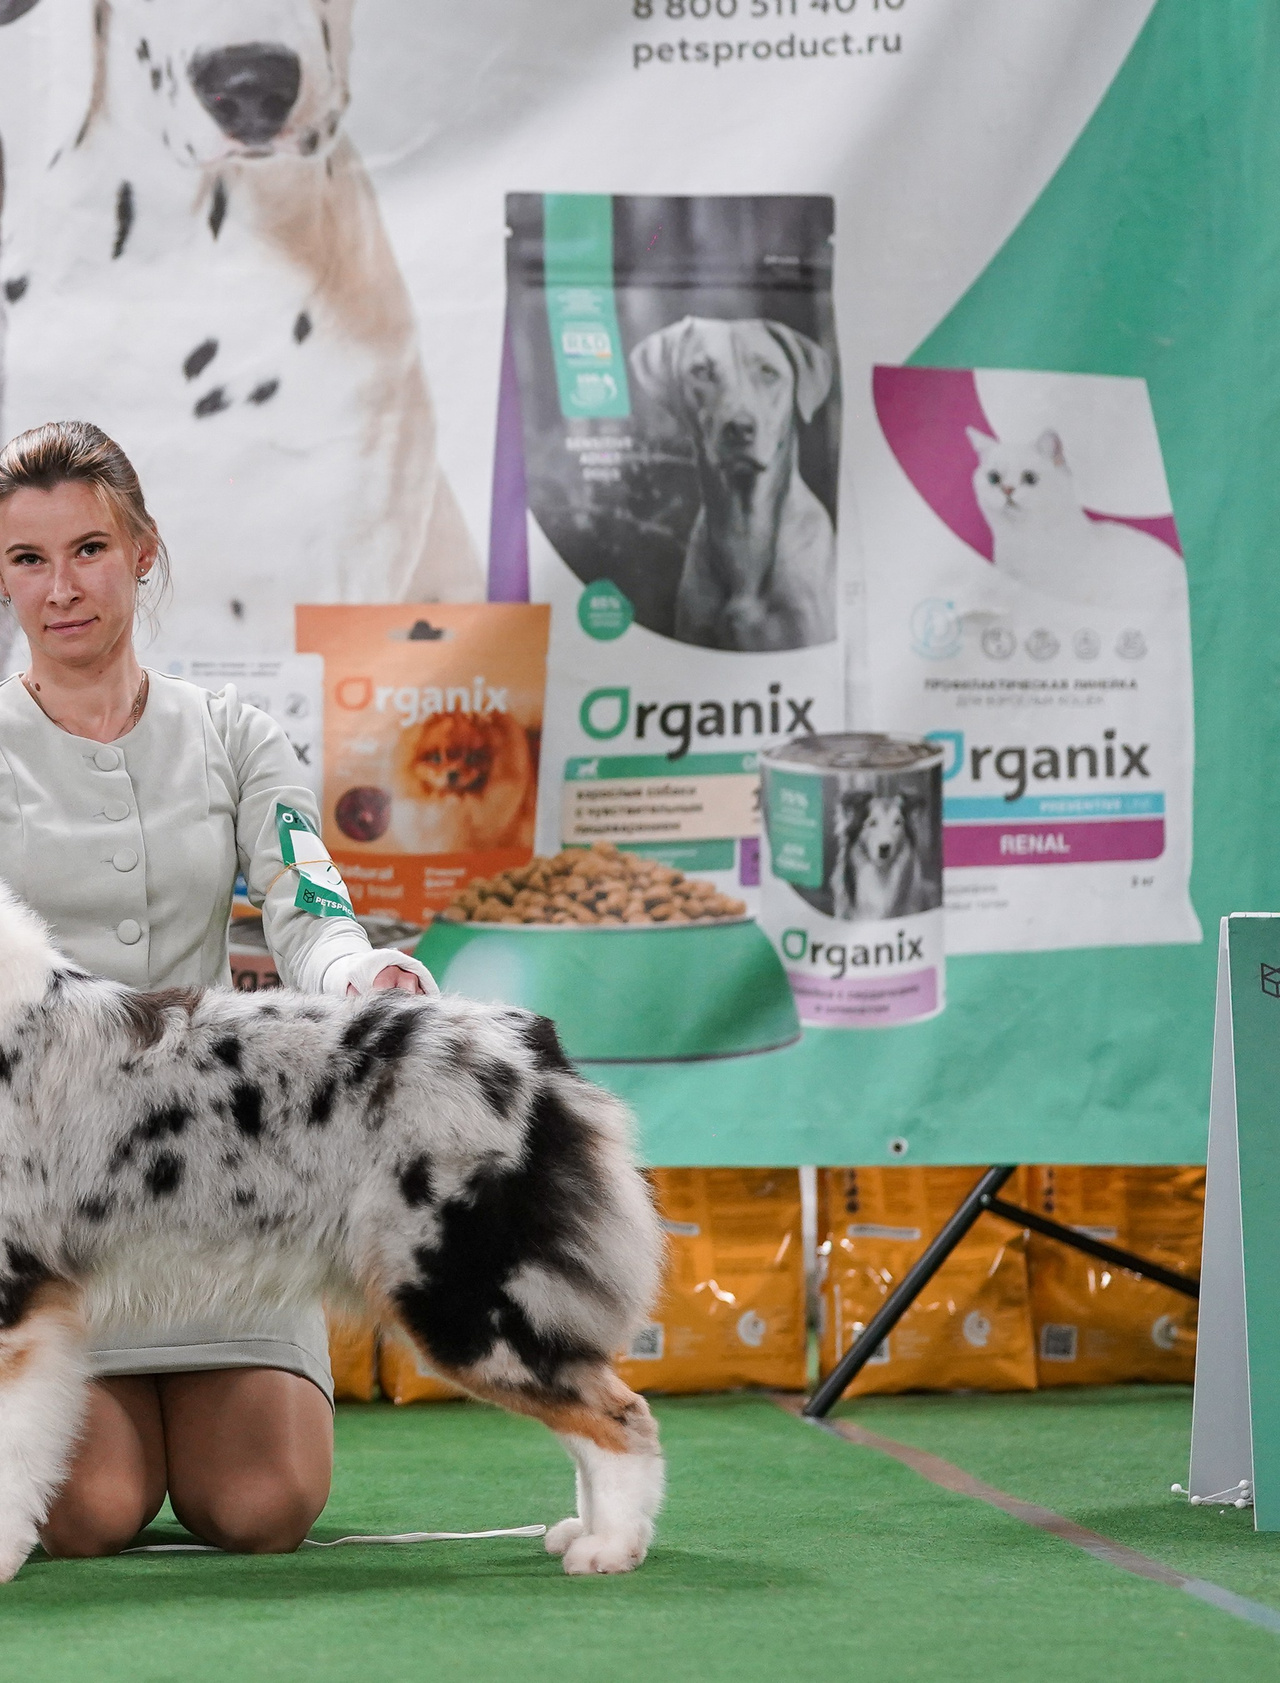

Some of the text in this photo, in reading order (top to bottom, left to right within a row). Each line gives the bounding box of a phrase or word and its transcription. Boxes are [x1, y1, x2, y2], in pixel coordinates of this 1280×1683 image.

[632, 32, 903, 69] petsproduct.ru
[334, 676, 508, 727] Organix
[579, 682, 817, 763] Organix
[999, 832, 1070, 856] RENAL
[782, 929, 924, 979] Organix
